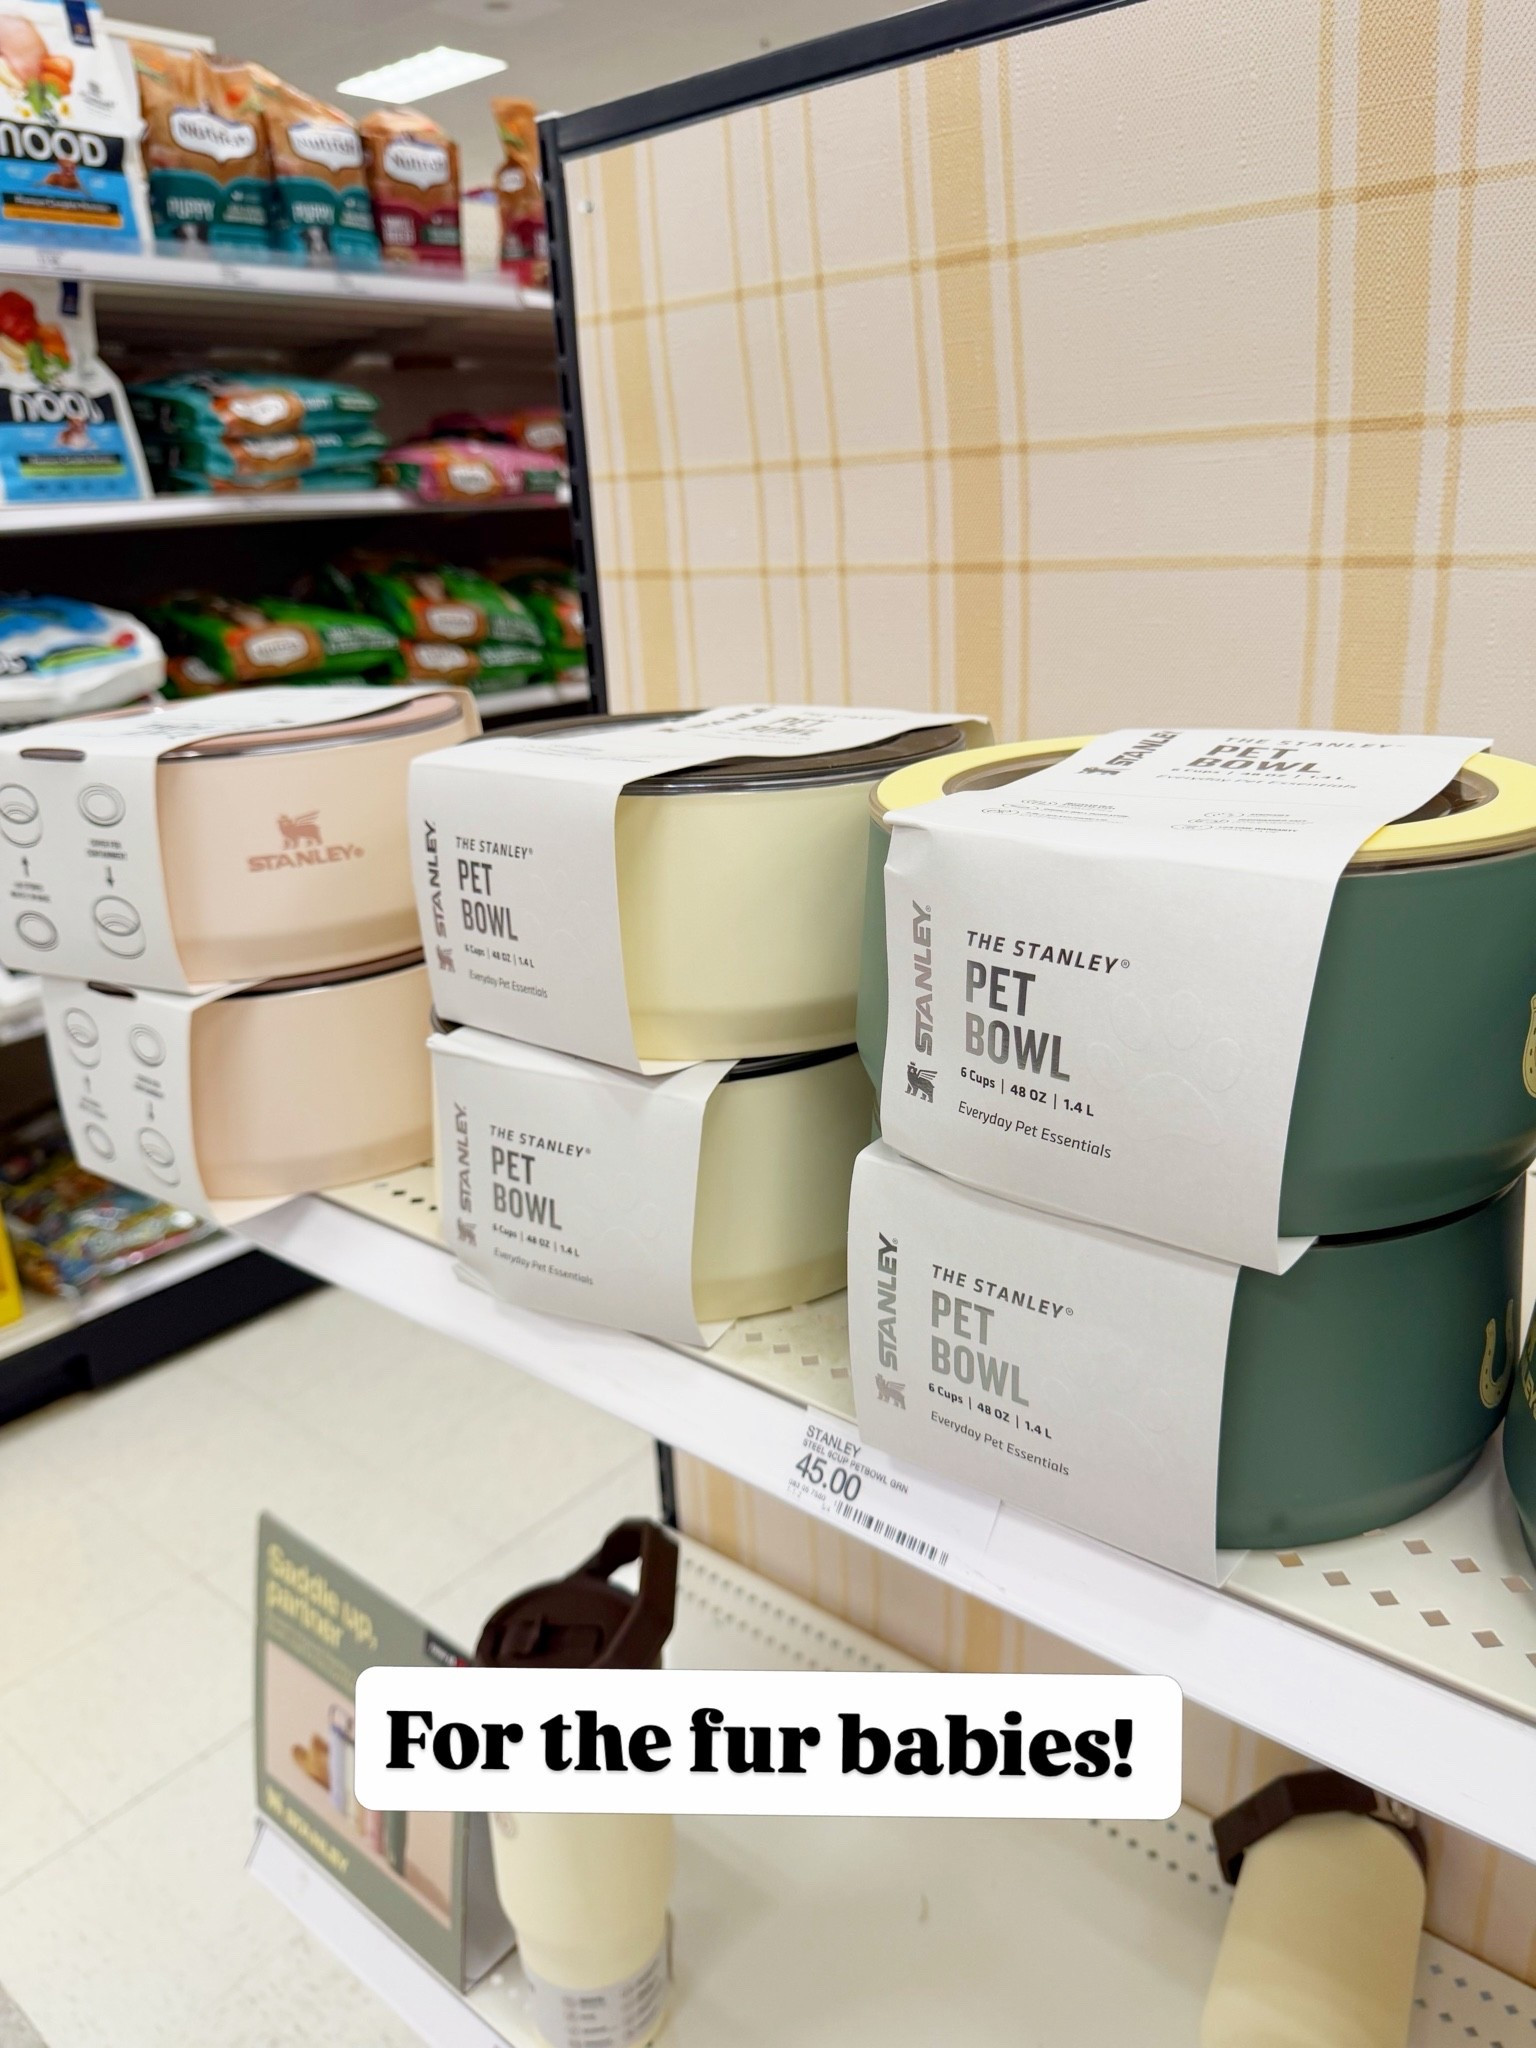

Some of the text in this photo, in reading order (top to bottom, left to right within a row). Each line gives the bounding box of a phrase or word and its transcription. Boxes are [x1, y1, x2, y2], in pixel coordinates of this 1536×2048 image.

[1186, 757, 1321, 774] BOWL
[1206, 744, 1299, 759] PET
[456, 836, 477, 851] THE
[457, 858, 492, 896] PET
[461, 898, 519, 942] BOWL
[966, 930, 1006, 954] THE
[511, 980, 548, 998] Essentials
[965, 959, 1037, 1017] PET
[965, 1011, 1071, 1083] BOWL
[960, 1067, 968, 1078] 6
[969, 1069, 996, 1089] Cups
[1010, 1083, 1028, 1099] 48
[1029, 1088, 1047, 1105] OZ
[1063, 1099, 1084, 1115] 1.4
[1086, 1103, 1095, 1117] L
[490, 1124, 515, 1141] THE
[958, 1100, 1112, 1159] Everyday Pet Essentials
[491, 1145, 535, 1185] PET
[493, 1182, 563, 1231] BOWL
[549, 1264, 594, 1286] Essentials
[932, 1264, 968, 1288] THE
[931, 1289, 995, 1346] PET
[931, 1334, 1030, 1407] BOWL
[928, 1382, 935, 1394] 6
[937, 1385, 963, 1405] Cups
[977, 1402, 992, 1417] 48
[994, 1407, 1010, 1424] OZ
[1025, 1420, 1042, 1436] 1.4
[1045, 1426, 1053, 1440] L
[806, 1424, 861, 1458] STANLEY
[931, 1410, 1070, 1476] Everyday Pet Essentials
[795, 1452, 862, 1502] 45.00
[802, 1438, 825, 1455] STEEL
[850, 1459, 888, 1485] PETBOWL
[889, 1478, 908, 1494] GRN
